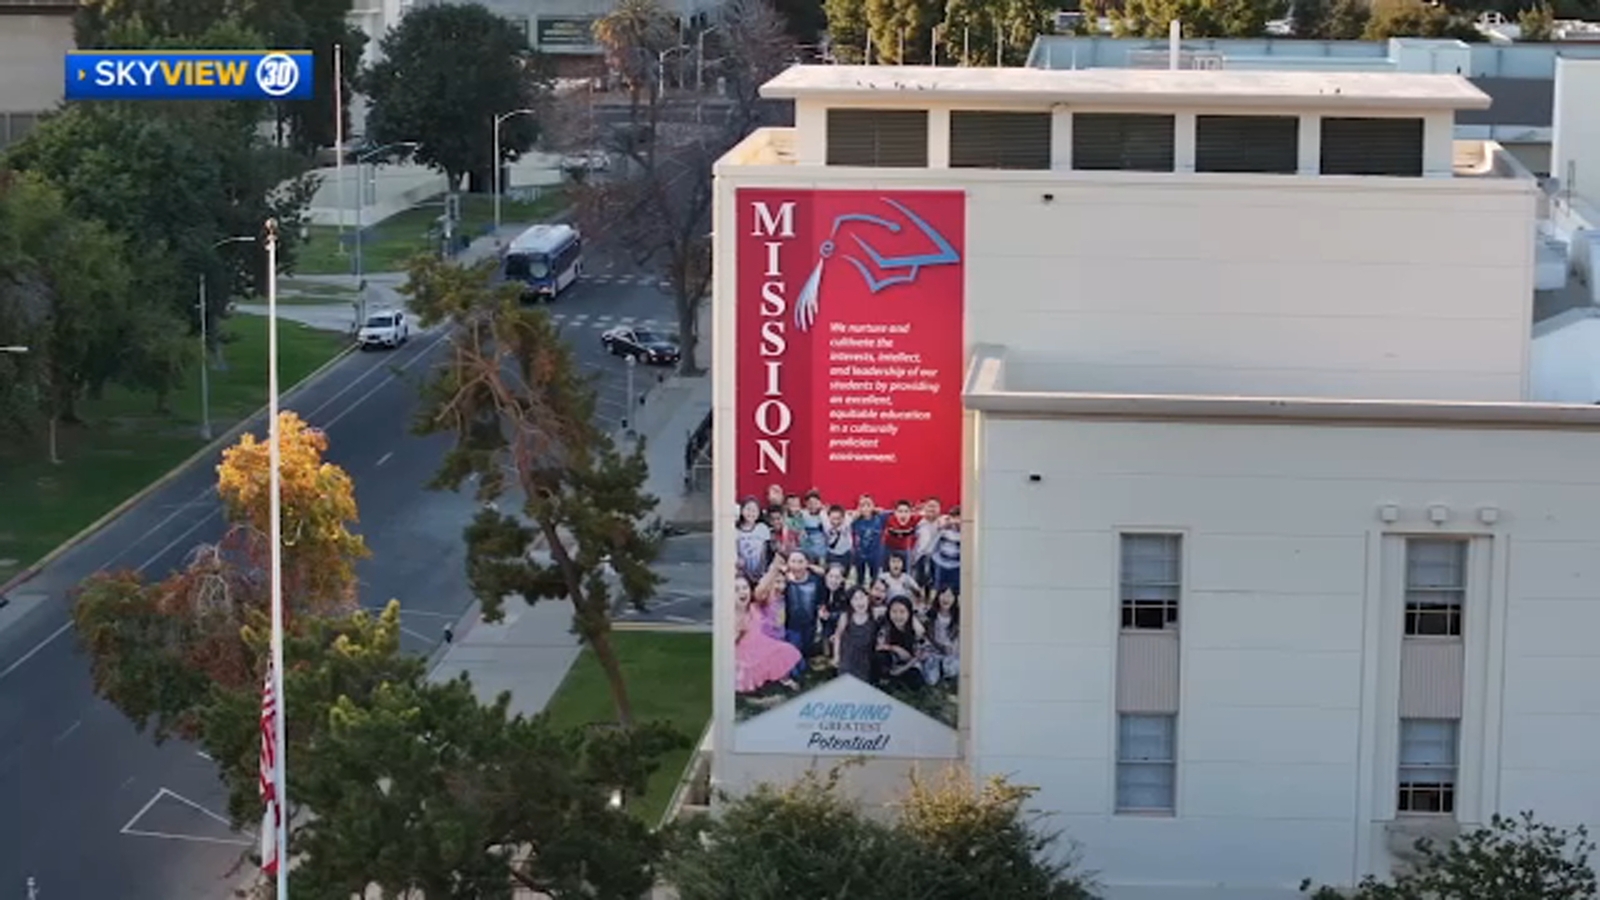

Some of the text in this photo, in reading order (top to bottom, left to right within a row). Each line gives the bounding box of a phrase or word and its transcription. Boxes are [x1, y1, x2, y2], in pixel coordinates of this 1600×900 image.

[829, 322, 910, 333] We nurture and
[750, 201, 796, 474] MISSION
[829, 337, 893, 348] cultivate the
[829, 366, 850, 376] and
[852, 366, 905, 378] leadership
[907, 366, 919, 376] of
[829, 380, 940, 393] students by providing
[829, 396, 843, 404] an
[829, 409, 931, 420] equitable education
[829, 424, 841, 433] in
[850, 423, 898, 436] culturally
[829, 438, 879, 449] proficient
[799, 702, 893, 721] ACHIEVING
[819, 722, 883, 732] GREATEST
[807, 732, 891, 750] Potential!
